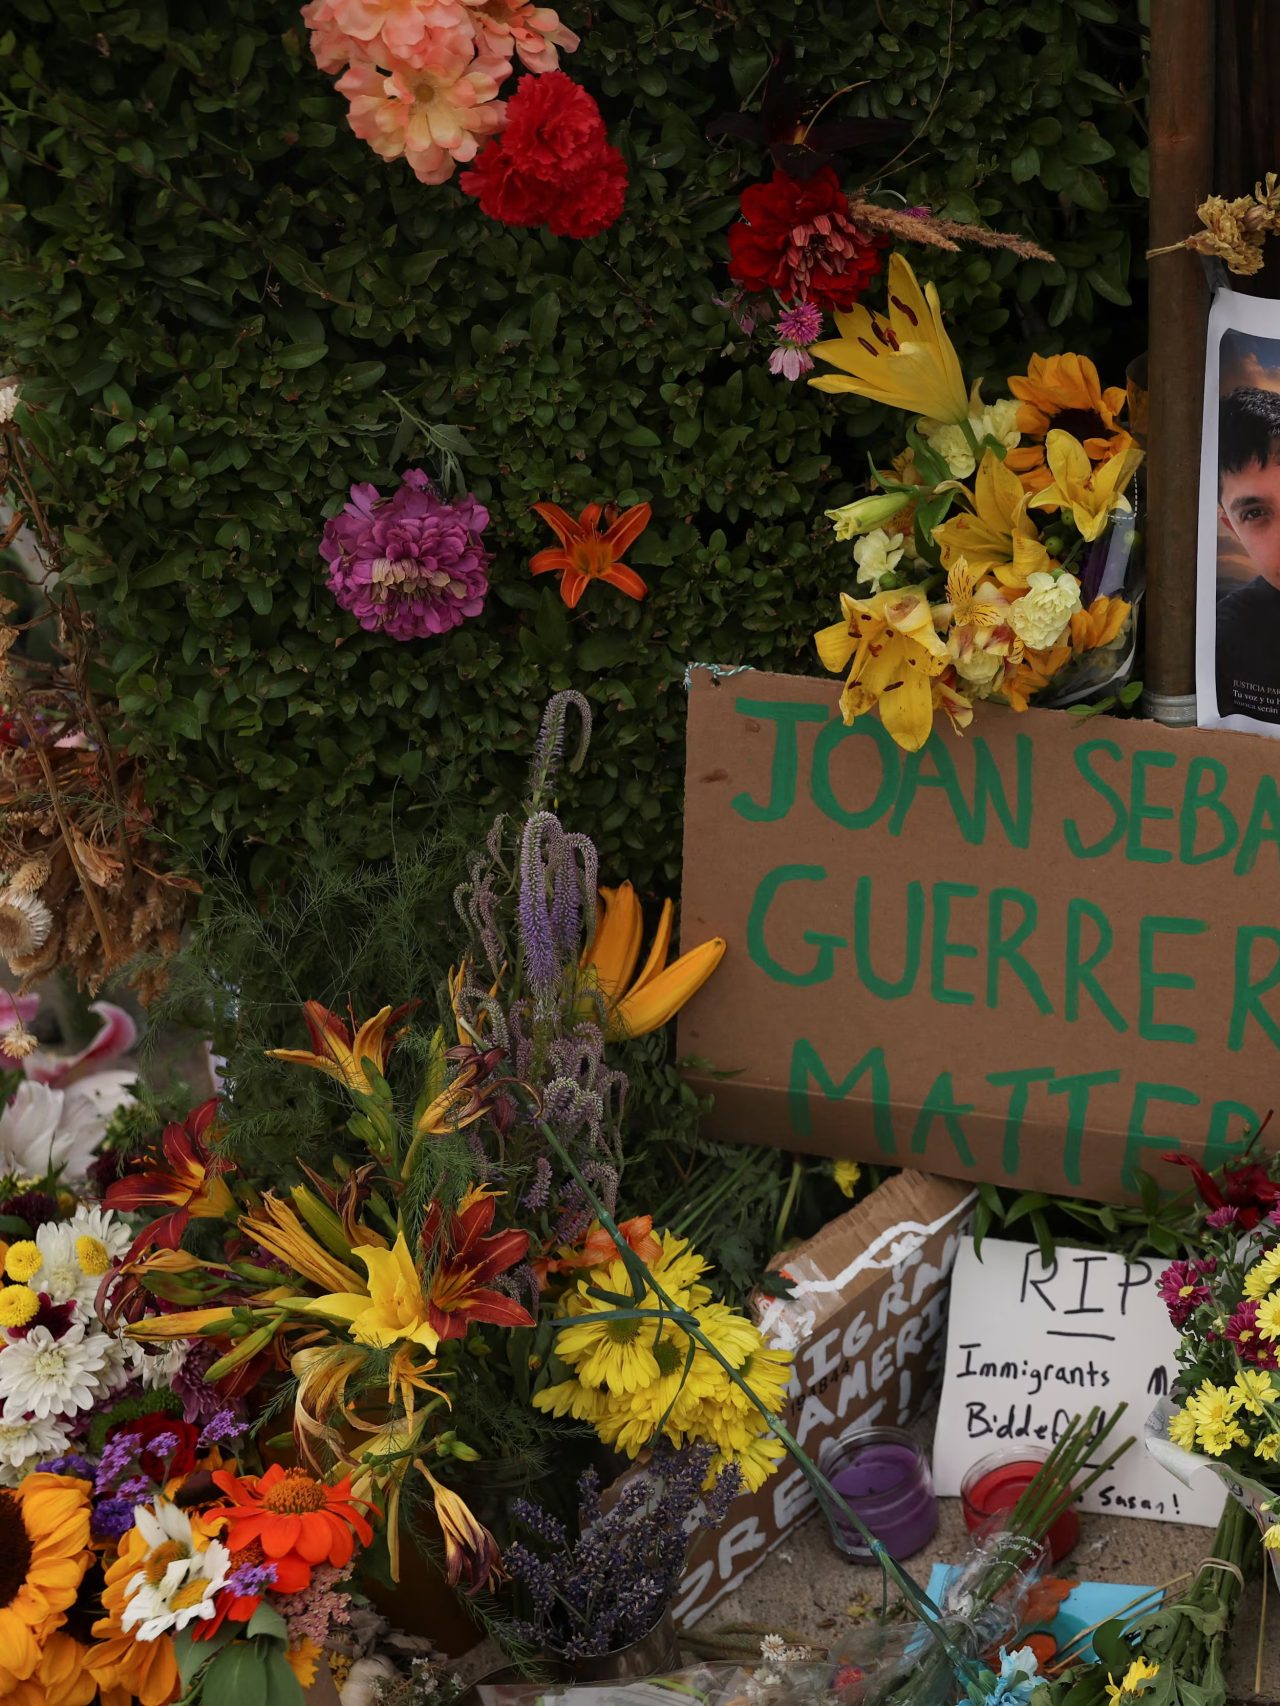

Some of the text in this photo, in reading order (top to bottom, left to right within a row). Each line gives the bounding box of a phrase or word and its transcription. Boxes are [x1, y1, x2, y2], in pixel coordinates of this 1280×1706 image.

[1232, 689, 1243, 698] Tu
[1244, 693, 1258, 702] voz
[1266, 697, 1275, 705] tu
[1233, 679, 1266, 693] JUSTICIA
[1257, 704, 1278, 714] serán
[730, 697, 1034, 849] JOAN
[1020, 1248, 1152, 1315] RIP
[797, 1285, 950, 1447] AMERI
[956, 1343, 1111, 1395] Immigrants
[966, 1401, 1106, 1447] Biddefd
